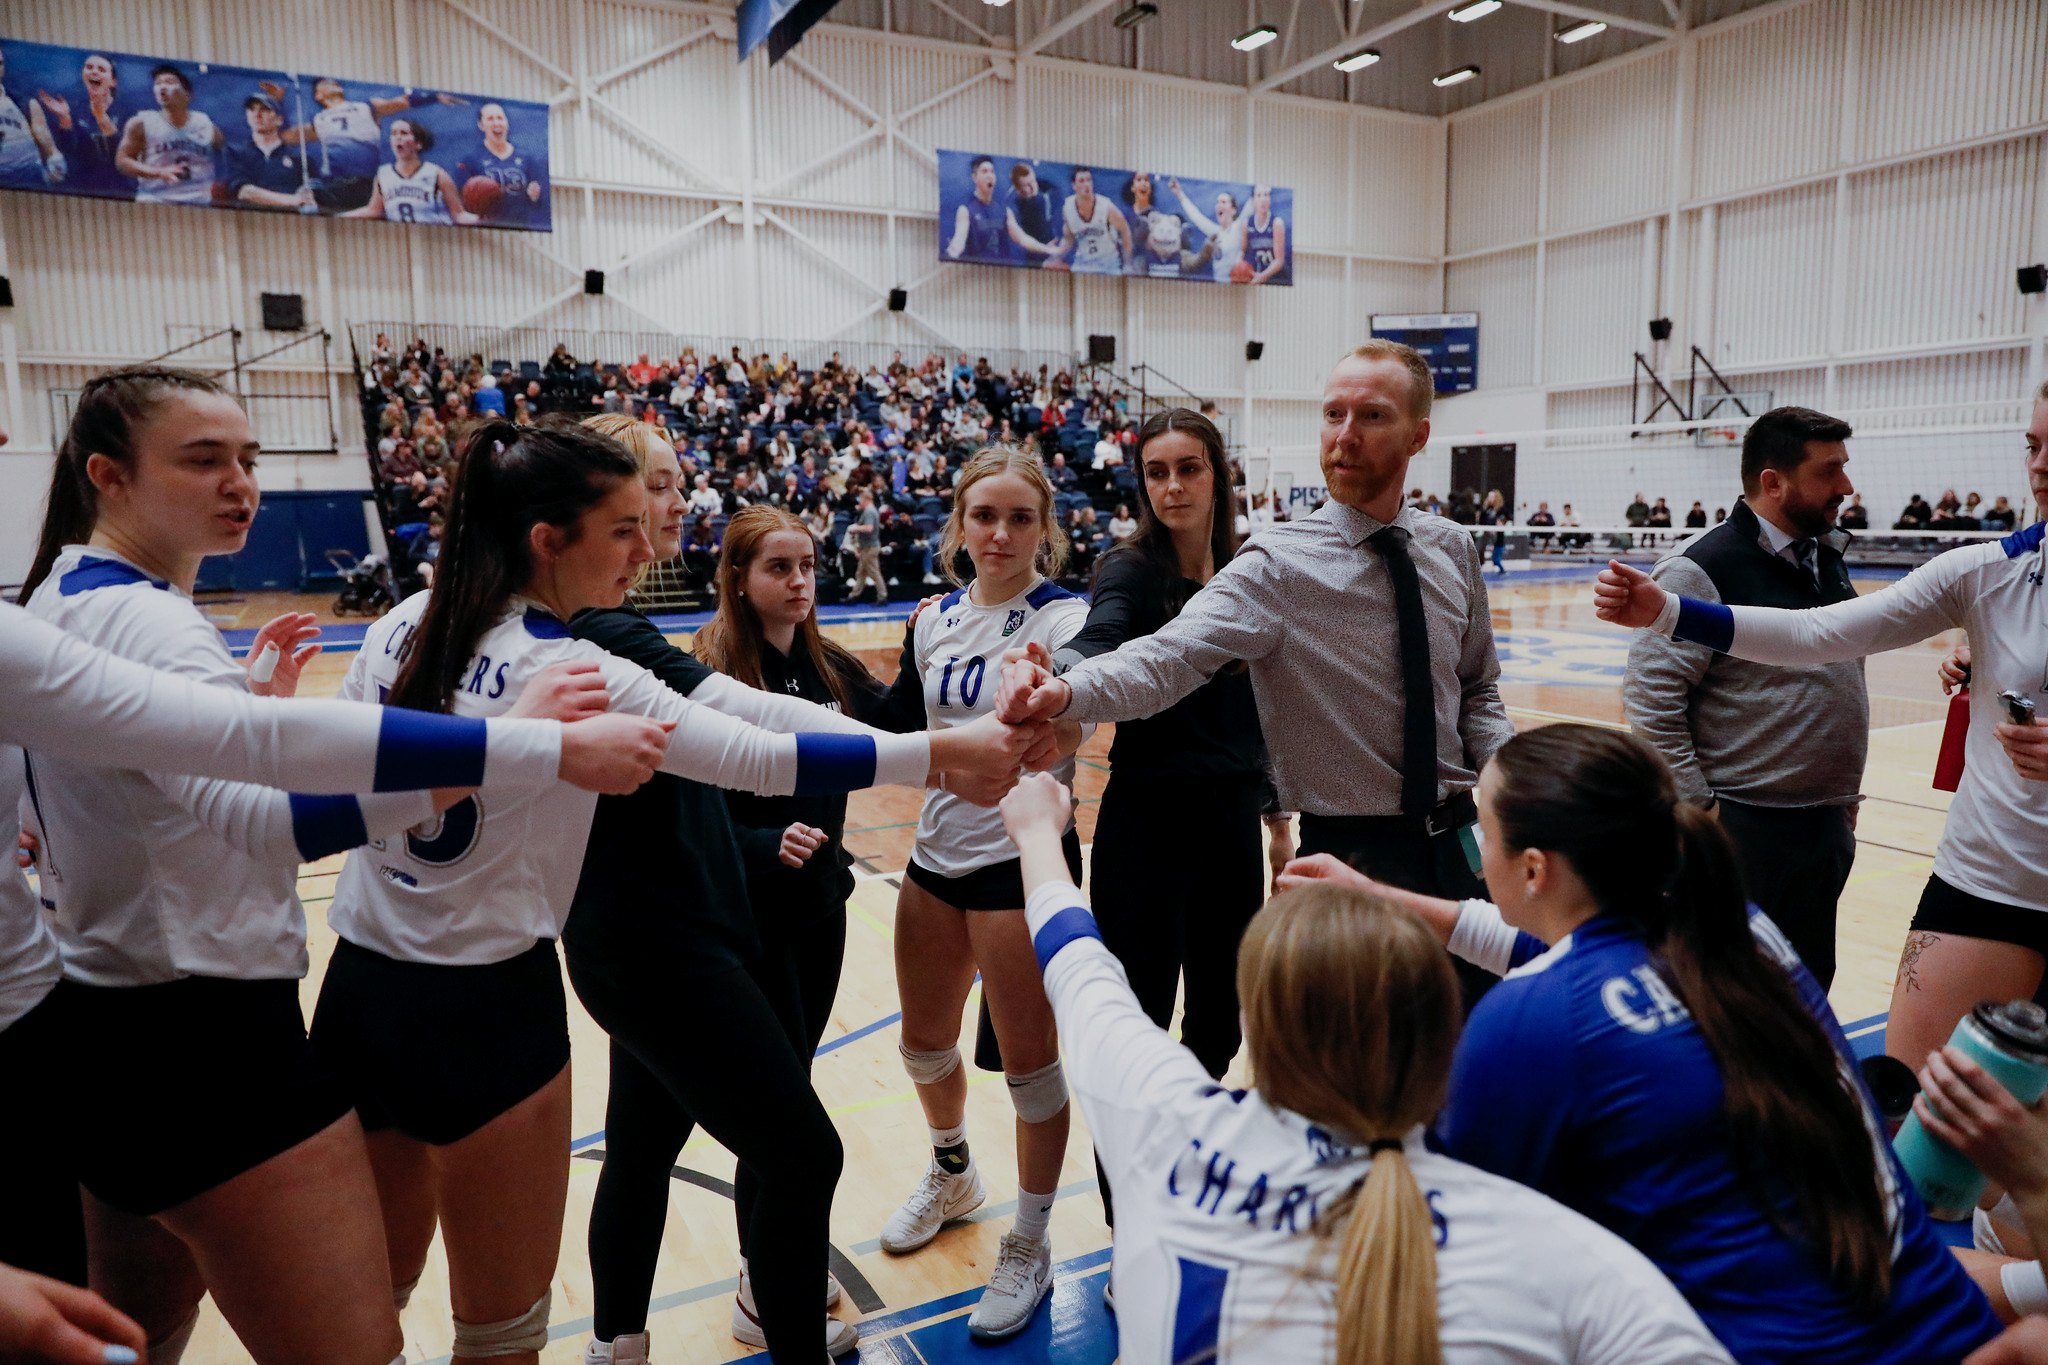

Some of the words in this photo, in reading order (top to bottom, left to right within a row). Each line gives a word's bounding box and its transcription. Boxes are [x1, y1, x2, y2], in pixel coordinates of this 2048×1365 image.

[1289, 487, 1328, 507] PIS
[937, 654, 987, 710] 10
[1168, 1138, 1449, 1250] CHARS
